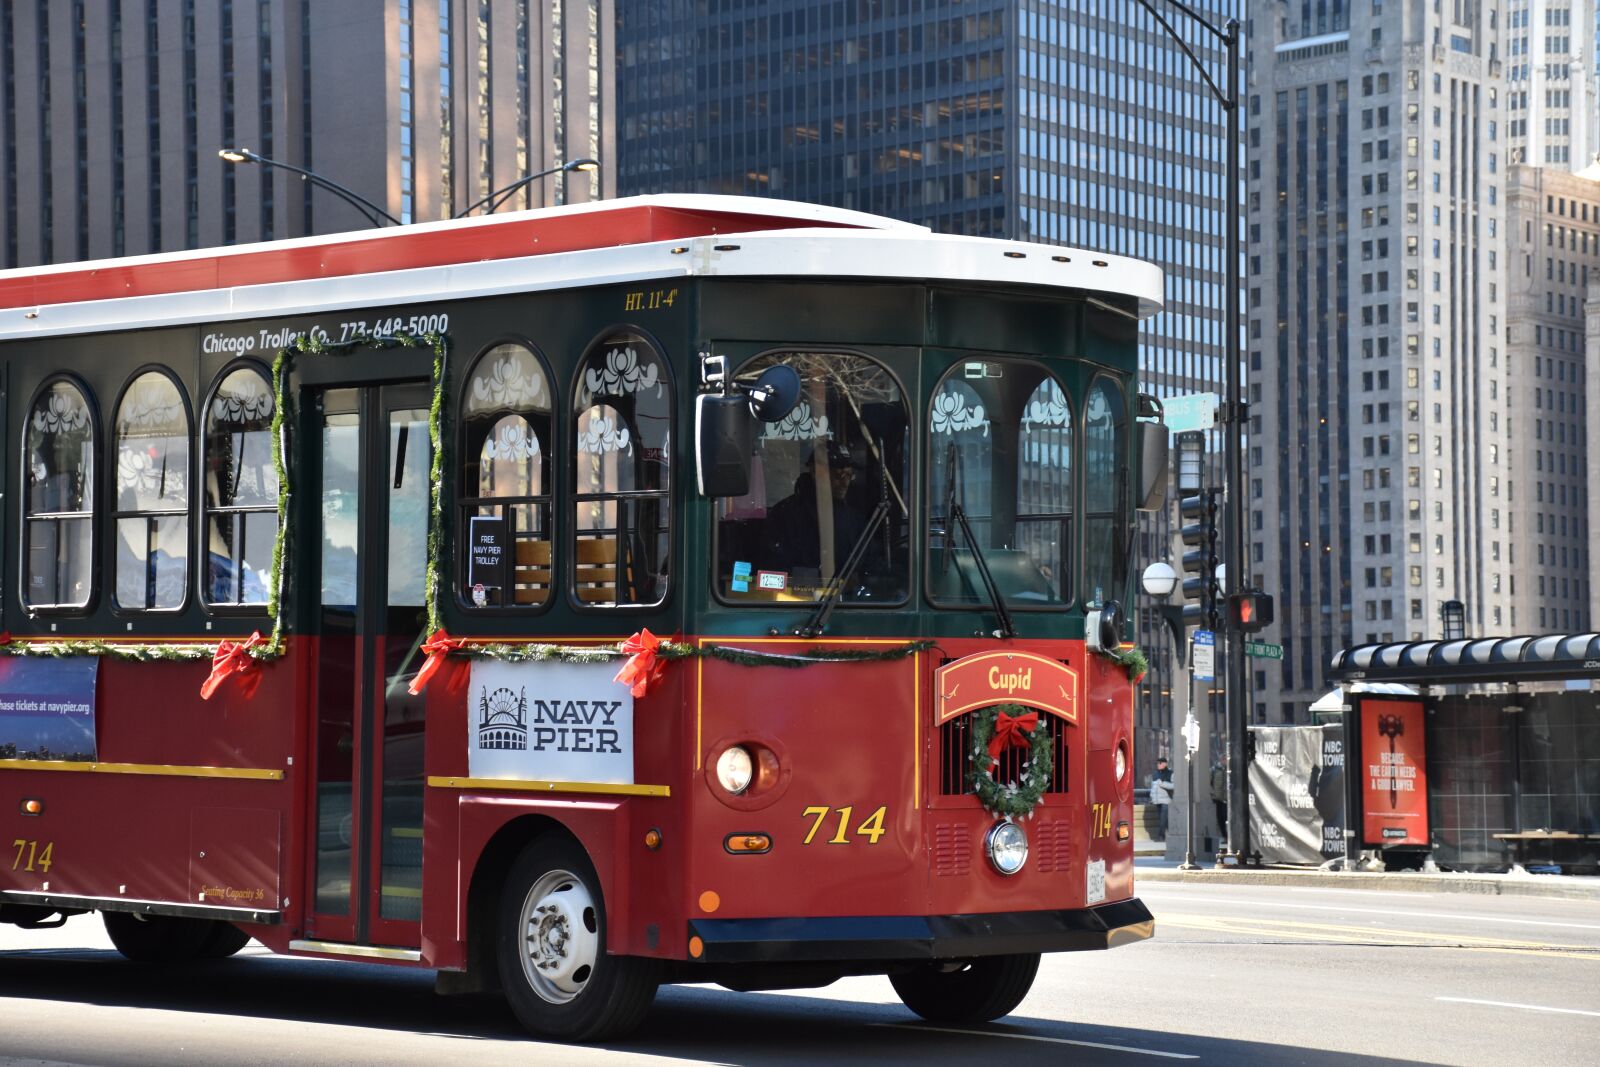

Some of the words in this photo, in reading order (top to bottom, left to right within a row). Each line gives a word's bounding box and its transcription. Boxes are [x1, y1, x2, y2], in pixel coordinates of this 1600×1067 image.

[625, 292, 645, 311] HT.
[203, 332, 255, 357] Chicago
[310, 325, 330, 344] Co.
[340, 313, 449, 343] 773-648-5000
[480, 535, 494, 544] FREE
[473, 546, 487, 554] NAVY
[488, 546, 501, 555] PIER
[475, 556, 499, 565] TROLLEY
[988, 665, 1032, 694] Cupid
[0, 699, 14, 711] hase
[15, 699, 38, 711] tickets
[39, 701, 46, 711] at
[47, 701, 90, 715] navypier.org
[533, 699, 622, 725] NAVY
[533, 727, 622, 754] PIER
[1263, 742, 1278, 753] NBC
[1324, 741, 1342, 753] NBC
[1323, 754, 1345, 766] TOWE
[1290, 796, 1314, 809] TOWER
[802, 806, 887, 845] 714
[1092, 802, 1112, 840] 714
[1324, 827, 1340, 839] NBC
[1324, 840, 1345, 852] TOWE
[12, 839, 53, 873] 714
[201, 884, 225, 900] Seating
[225, 886, 254, 902] Capacity
[255, 888, 264, 899] 36
